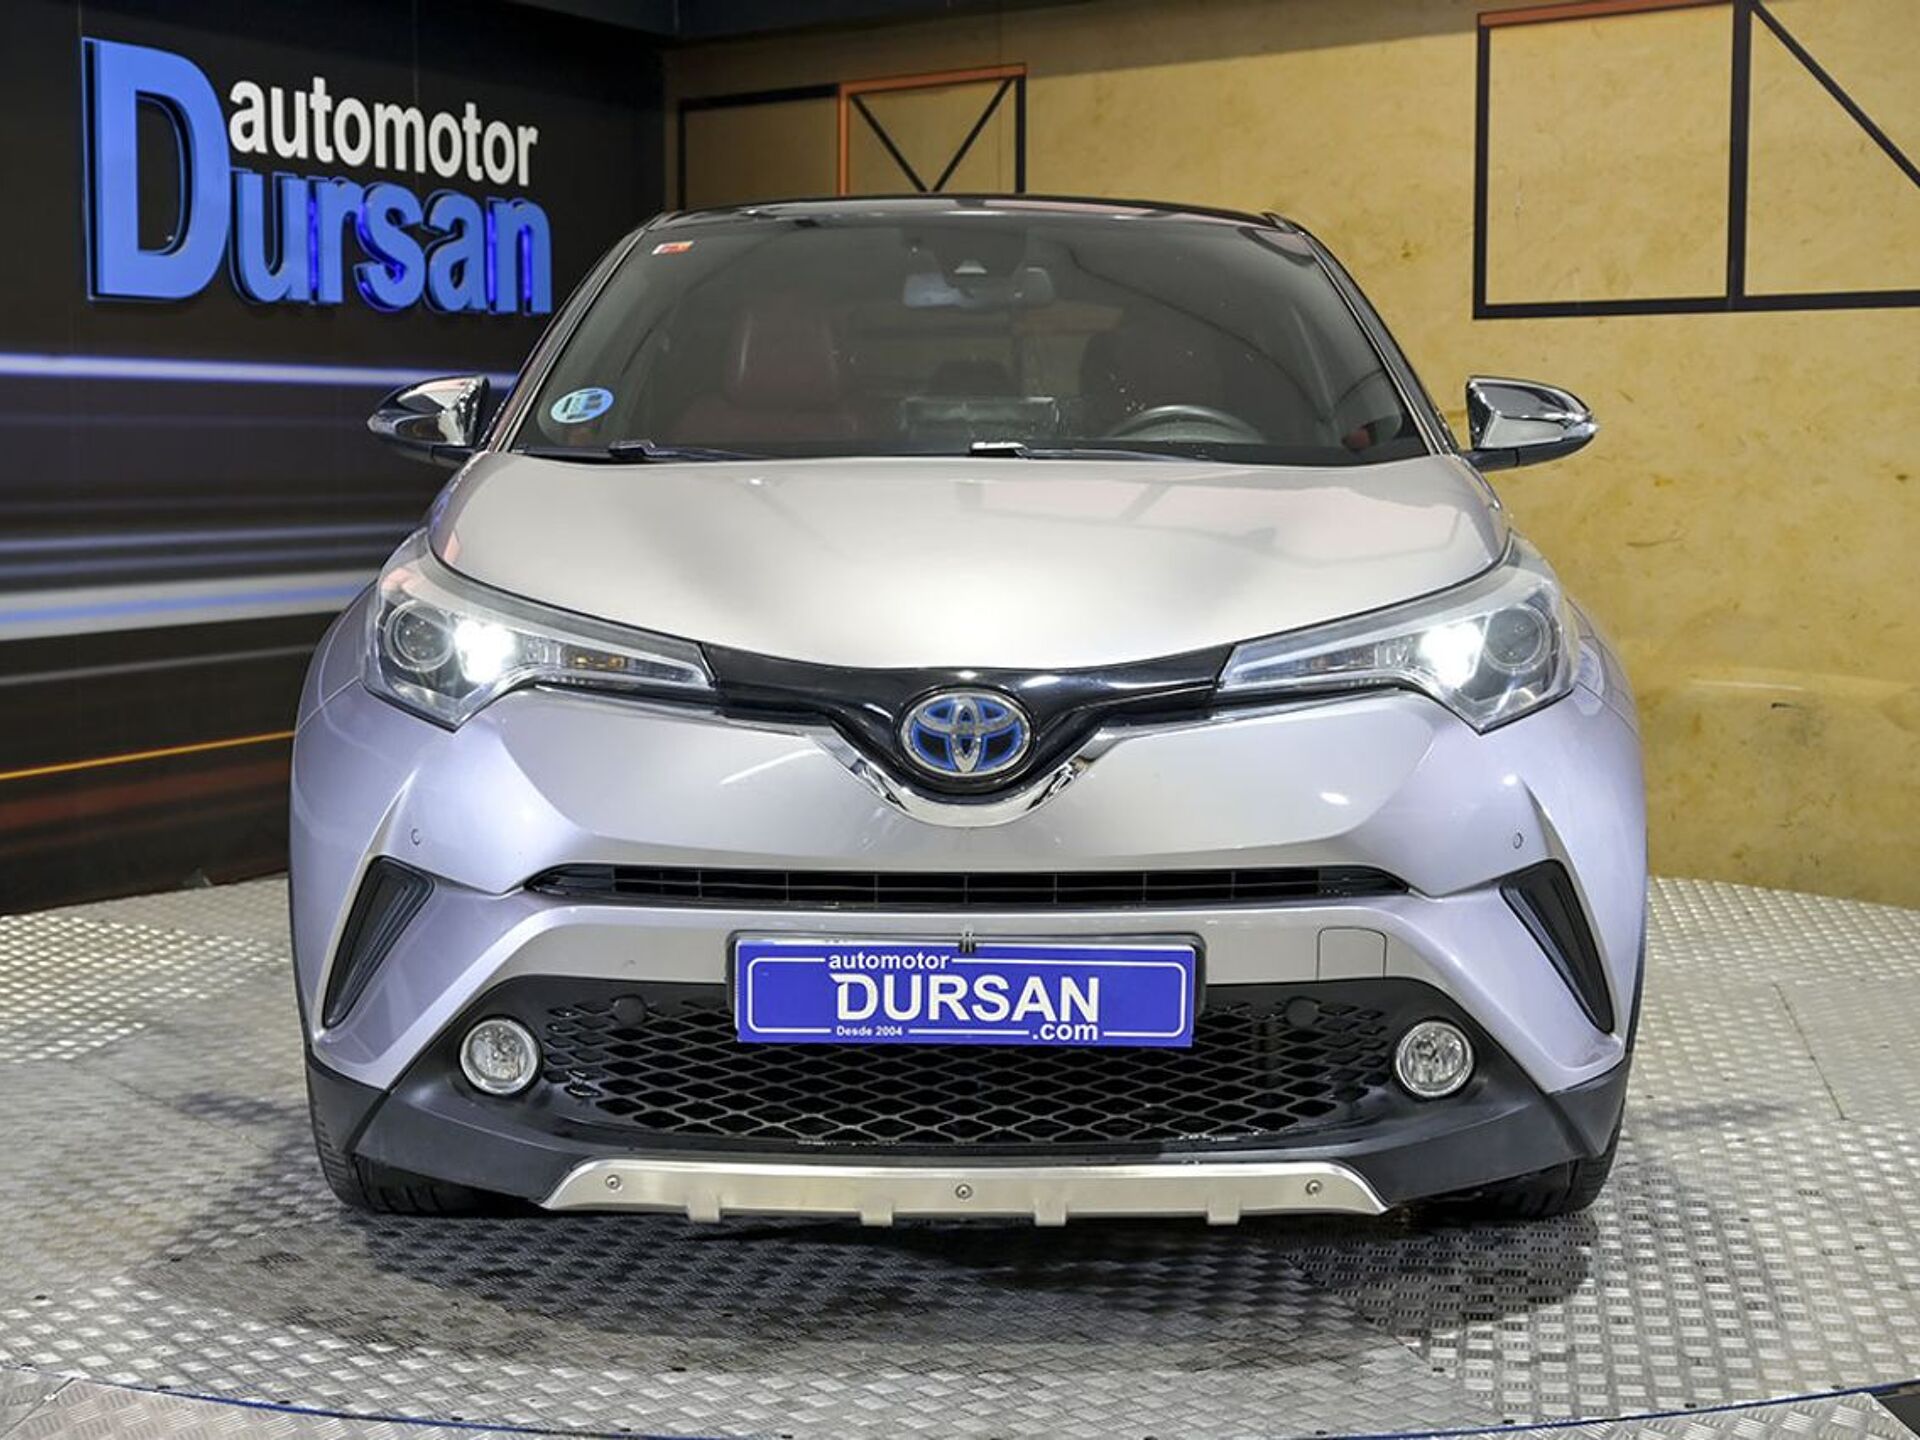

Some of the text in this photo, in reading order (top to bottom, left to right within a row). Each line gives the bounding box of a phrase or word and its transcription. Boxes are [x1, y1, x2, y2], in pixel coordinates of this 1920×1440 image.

[229, 76, 539, 187] automotor
[82, 37, 552, 315] Dursan
[828, 951, 950, 970] automotor
[829, 973, 1099, 1023] DURSAN
[836, 1025, 903, 1037] Desde 2004
[1032, 1023, 1099, 1041] .com
